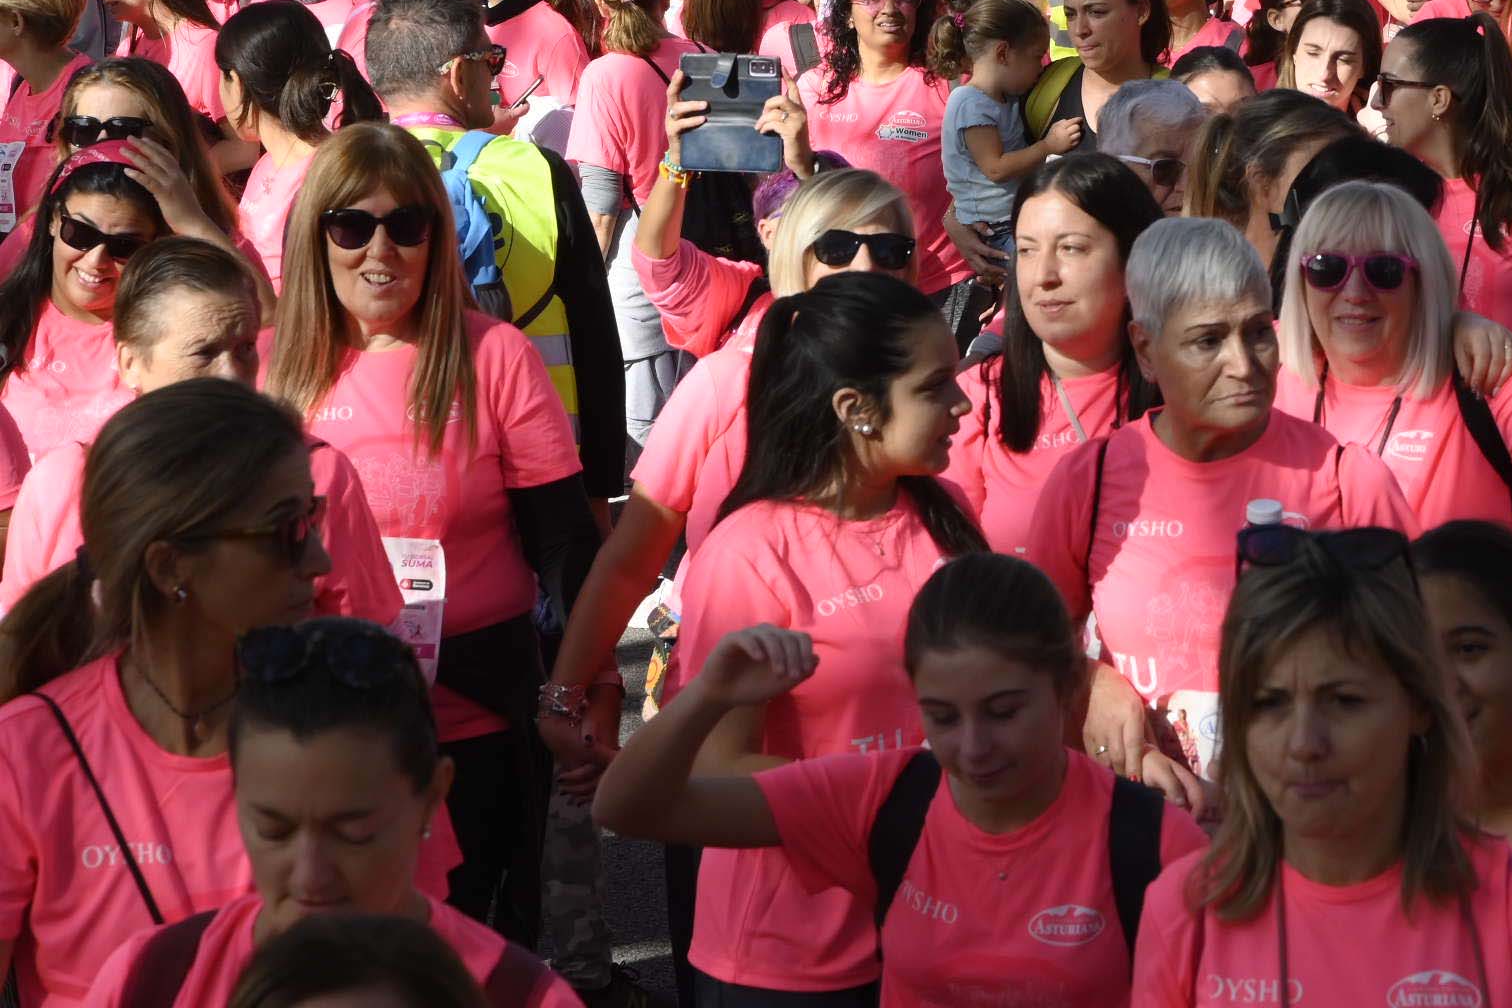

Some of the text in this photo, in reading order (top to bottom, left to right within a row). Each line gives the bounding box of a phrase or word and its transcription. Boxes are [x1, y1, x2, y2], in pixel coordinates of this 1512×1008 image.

[895, 126, 928, 140] Women
[1112, 520, 1183, 538] OYSHO
[401, 559, 433, 569] SUMA
[816, 582, 884, 617] OYSHO
